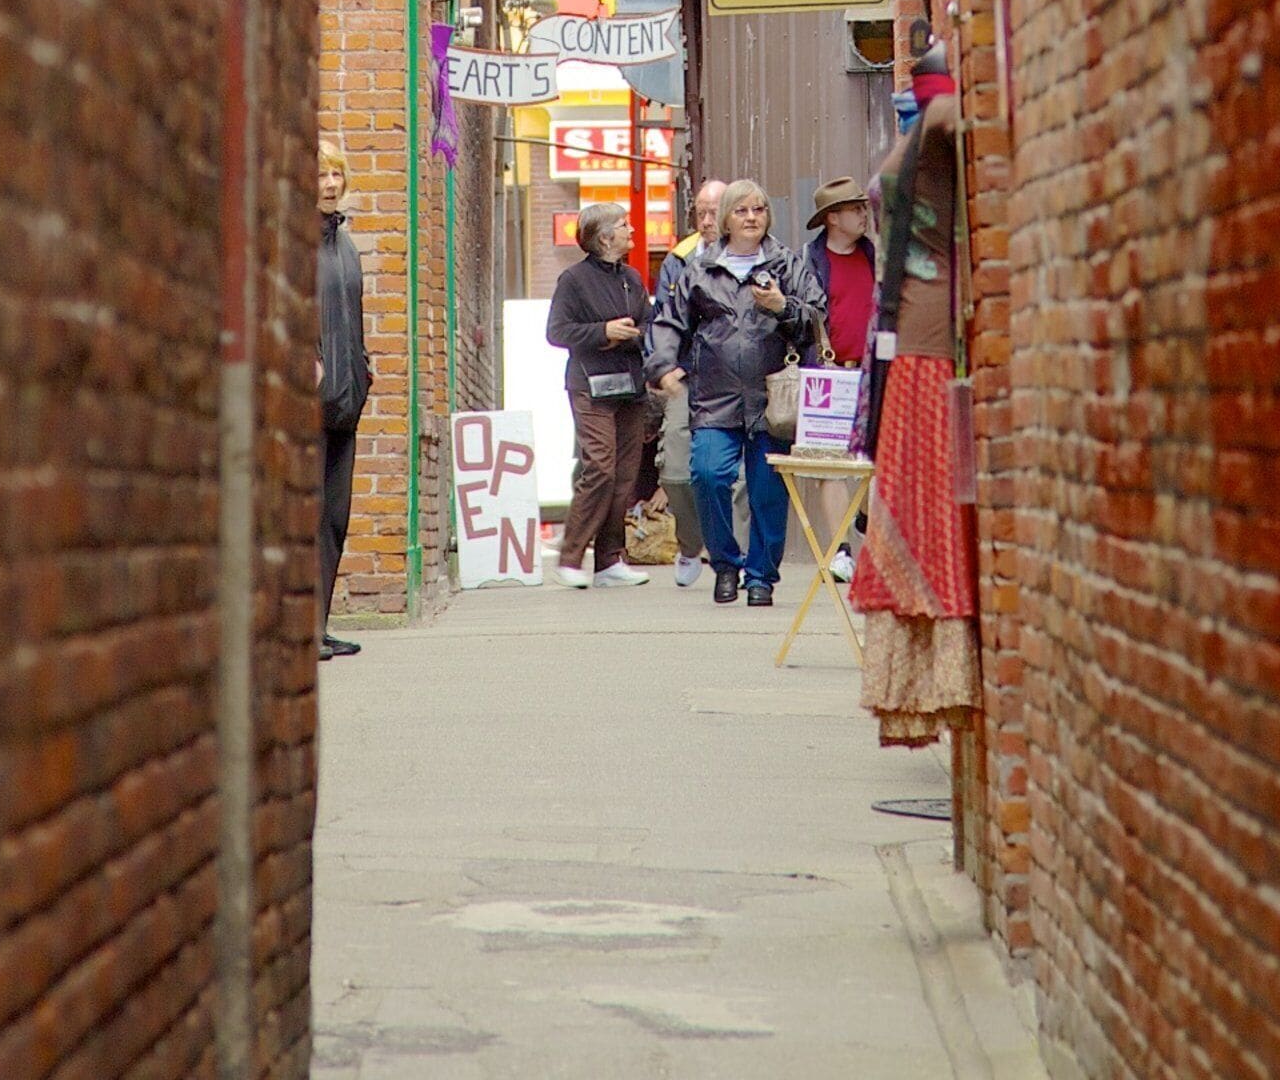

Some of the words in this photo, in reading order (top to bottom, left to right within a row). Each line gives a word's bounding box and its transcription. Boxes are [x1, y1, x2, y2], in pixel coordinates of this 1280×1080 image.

[447, 56, 550, 97] EART'S
[561, 18, 668, 56] CONTENT
[563, 128, 670, 159] SEA
[454, 415, 536, 574] OPEN
